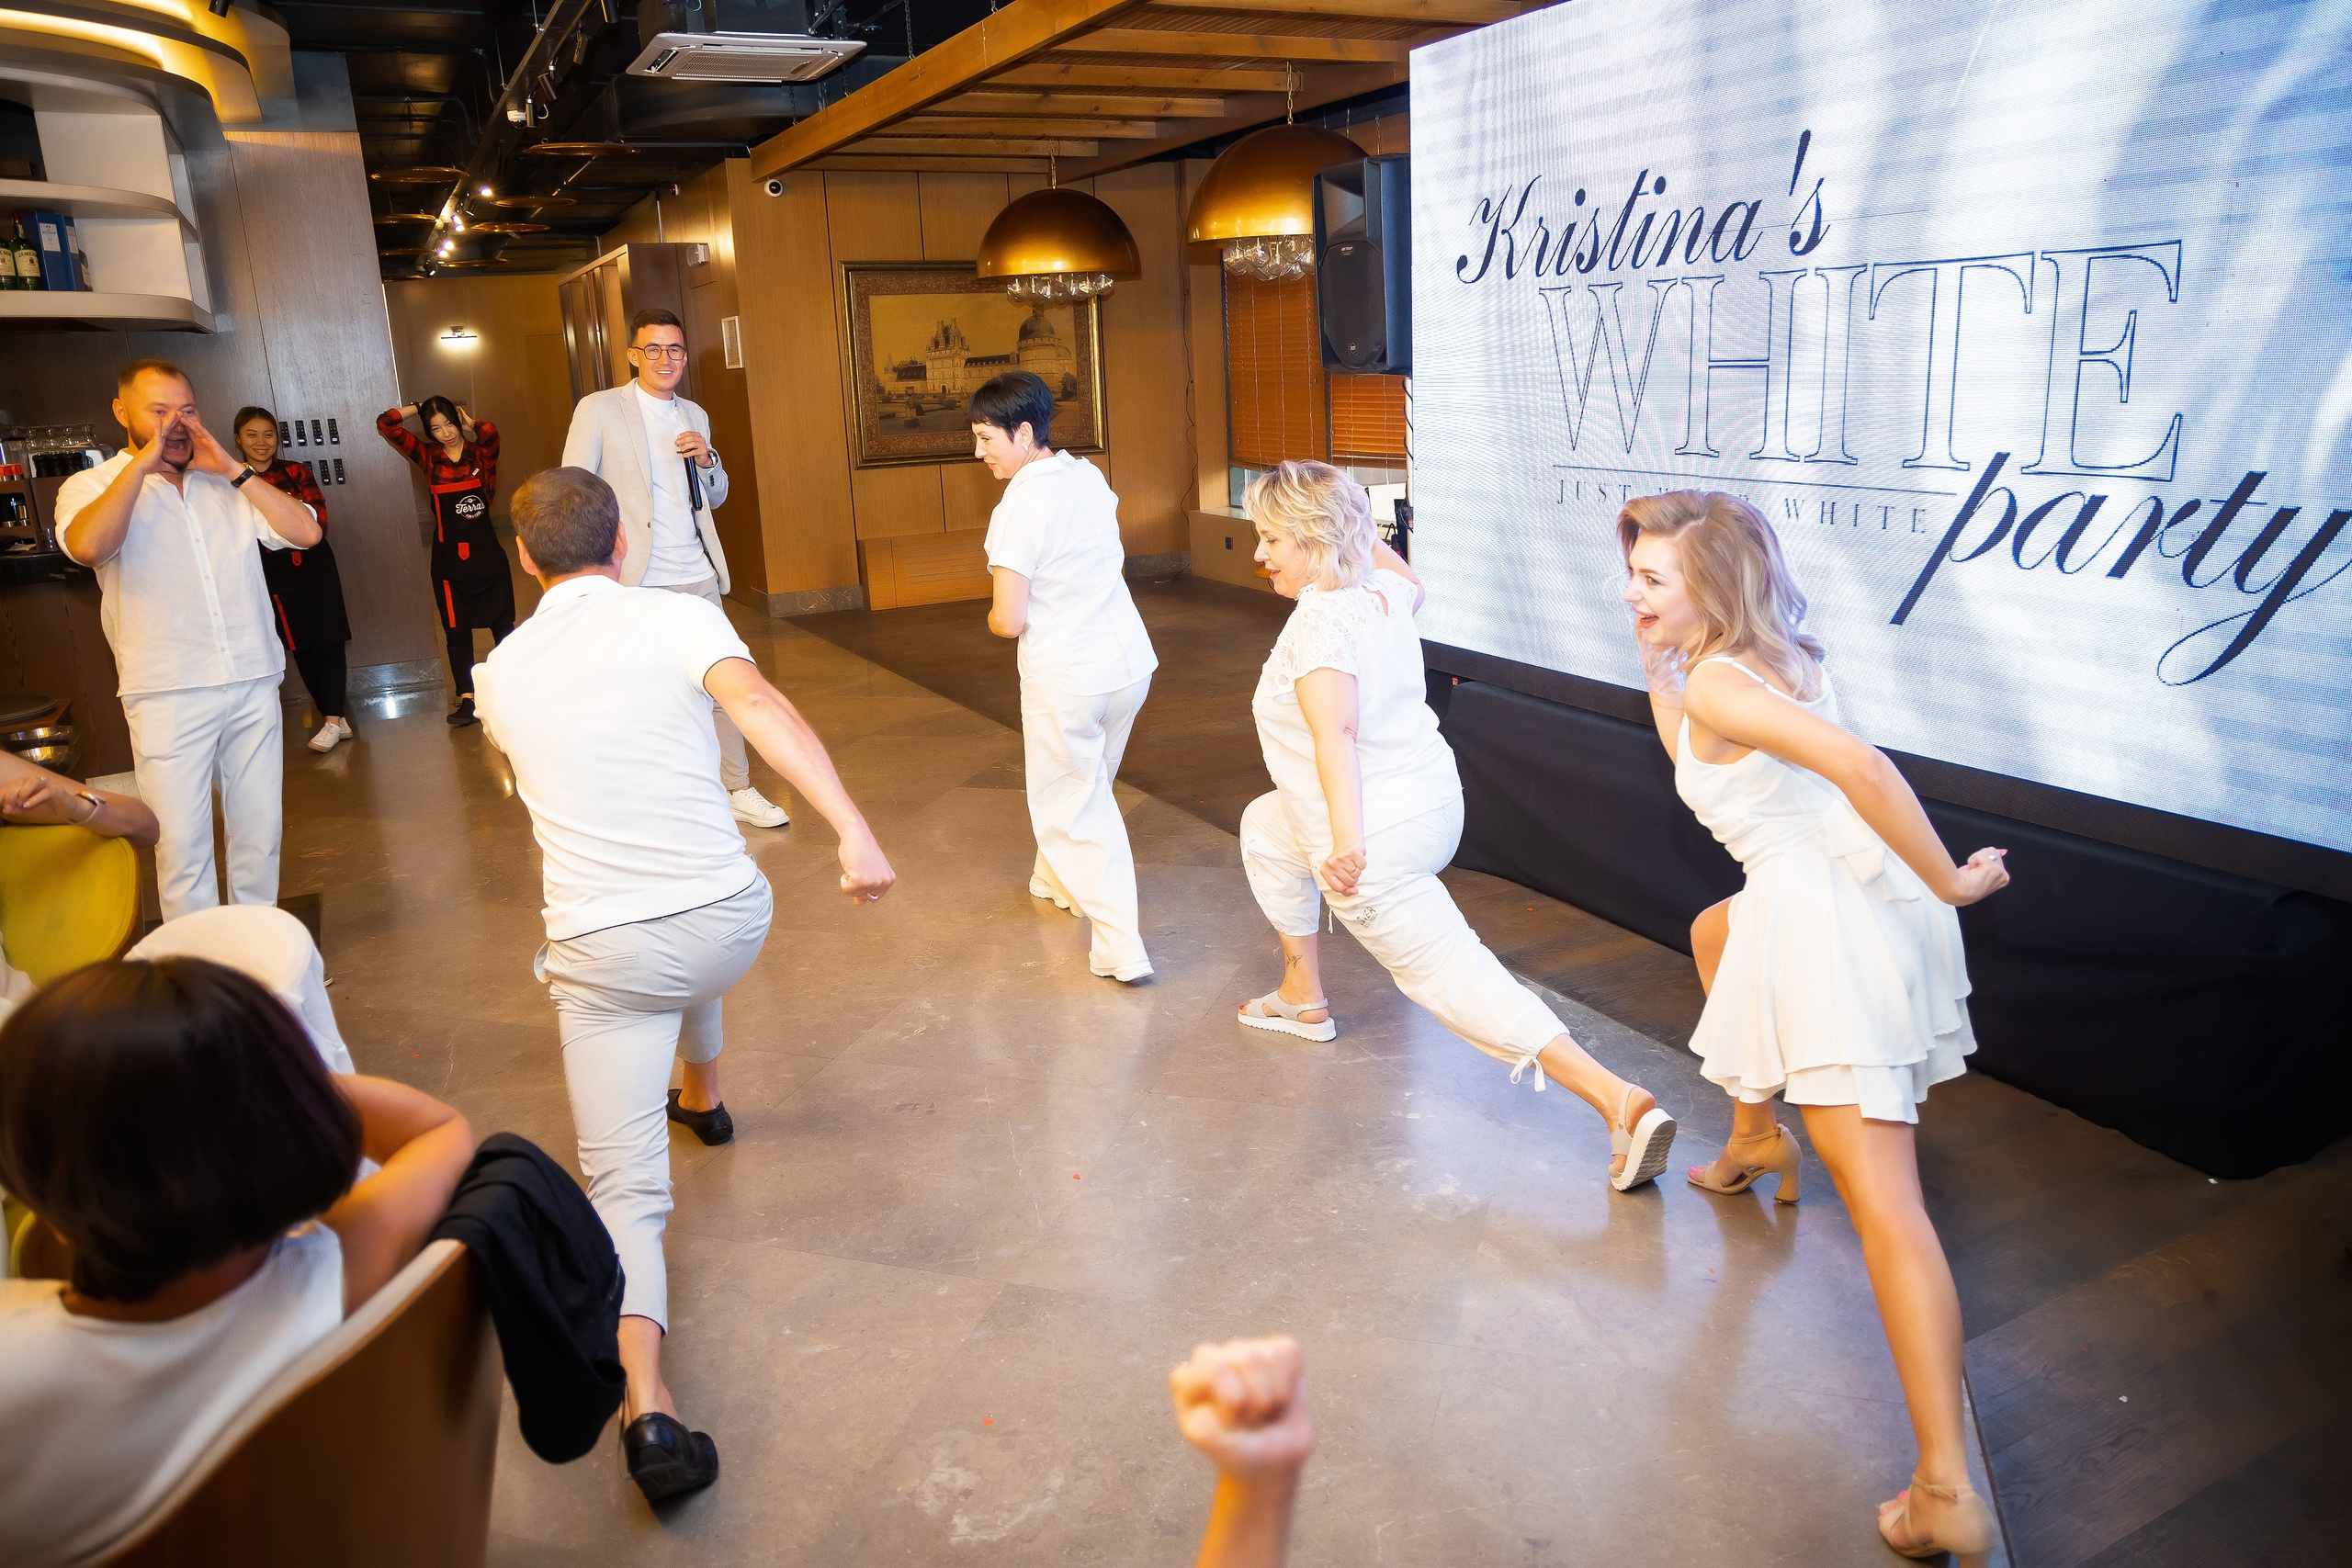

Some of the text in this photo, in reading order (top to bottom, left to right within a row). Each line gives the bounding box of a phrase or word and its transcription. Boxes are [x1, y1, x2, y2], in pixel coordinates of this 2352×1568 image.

[1457, 130, 1831, 284] Kristina's
[1538, 240, 2183, 482] WHITE
[1556, 479, 1632, 504] JUST
[1784, 497, 1927, 534] WHITE
[1889, 451, 2352, 687] party
